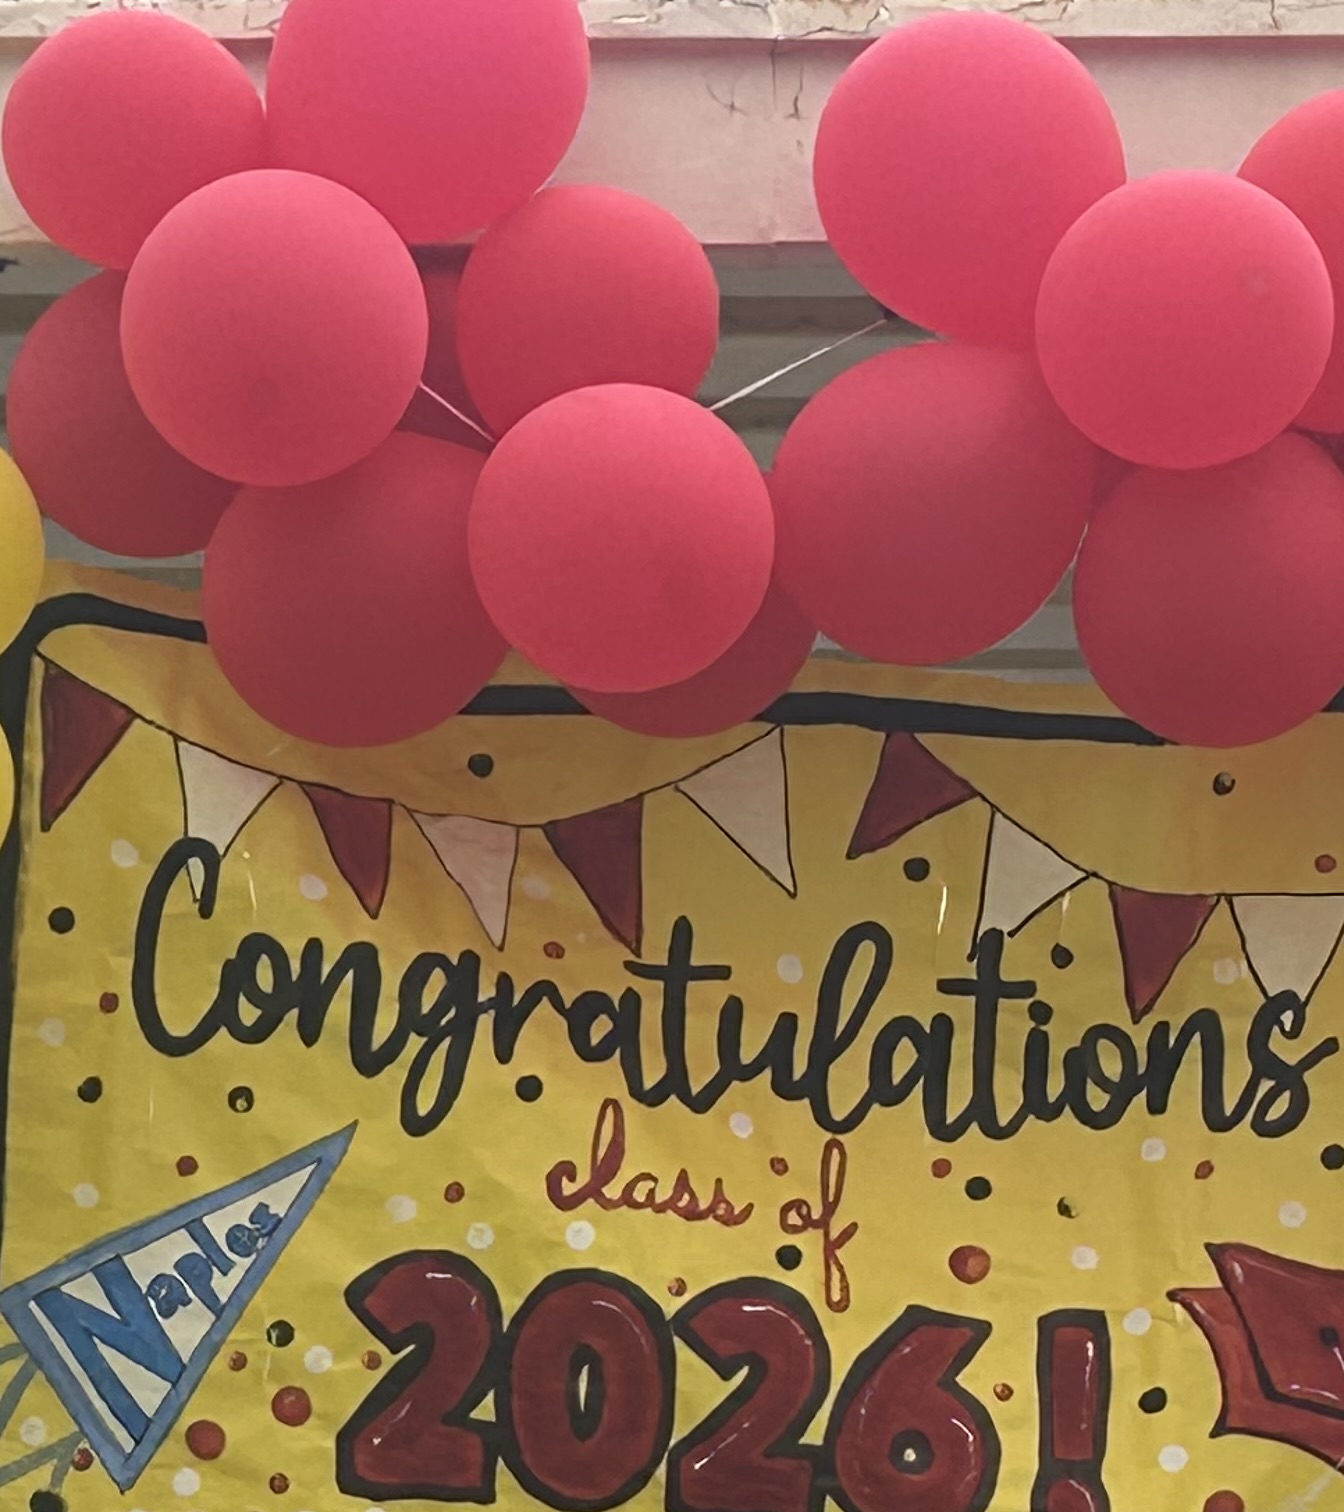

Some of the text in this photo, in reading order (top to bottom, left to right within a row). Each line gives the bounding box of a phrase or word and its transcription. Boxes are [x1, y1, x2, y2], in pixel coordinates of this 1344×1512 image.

[131, 836, 1341, 1143] Congratulations
[30, 1201, 284, 1446] Naples
[545, 1097, 859, 1313] class of
